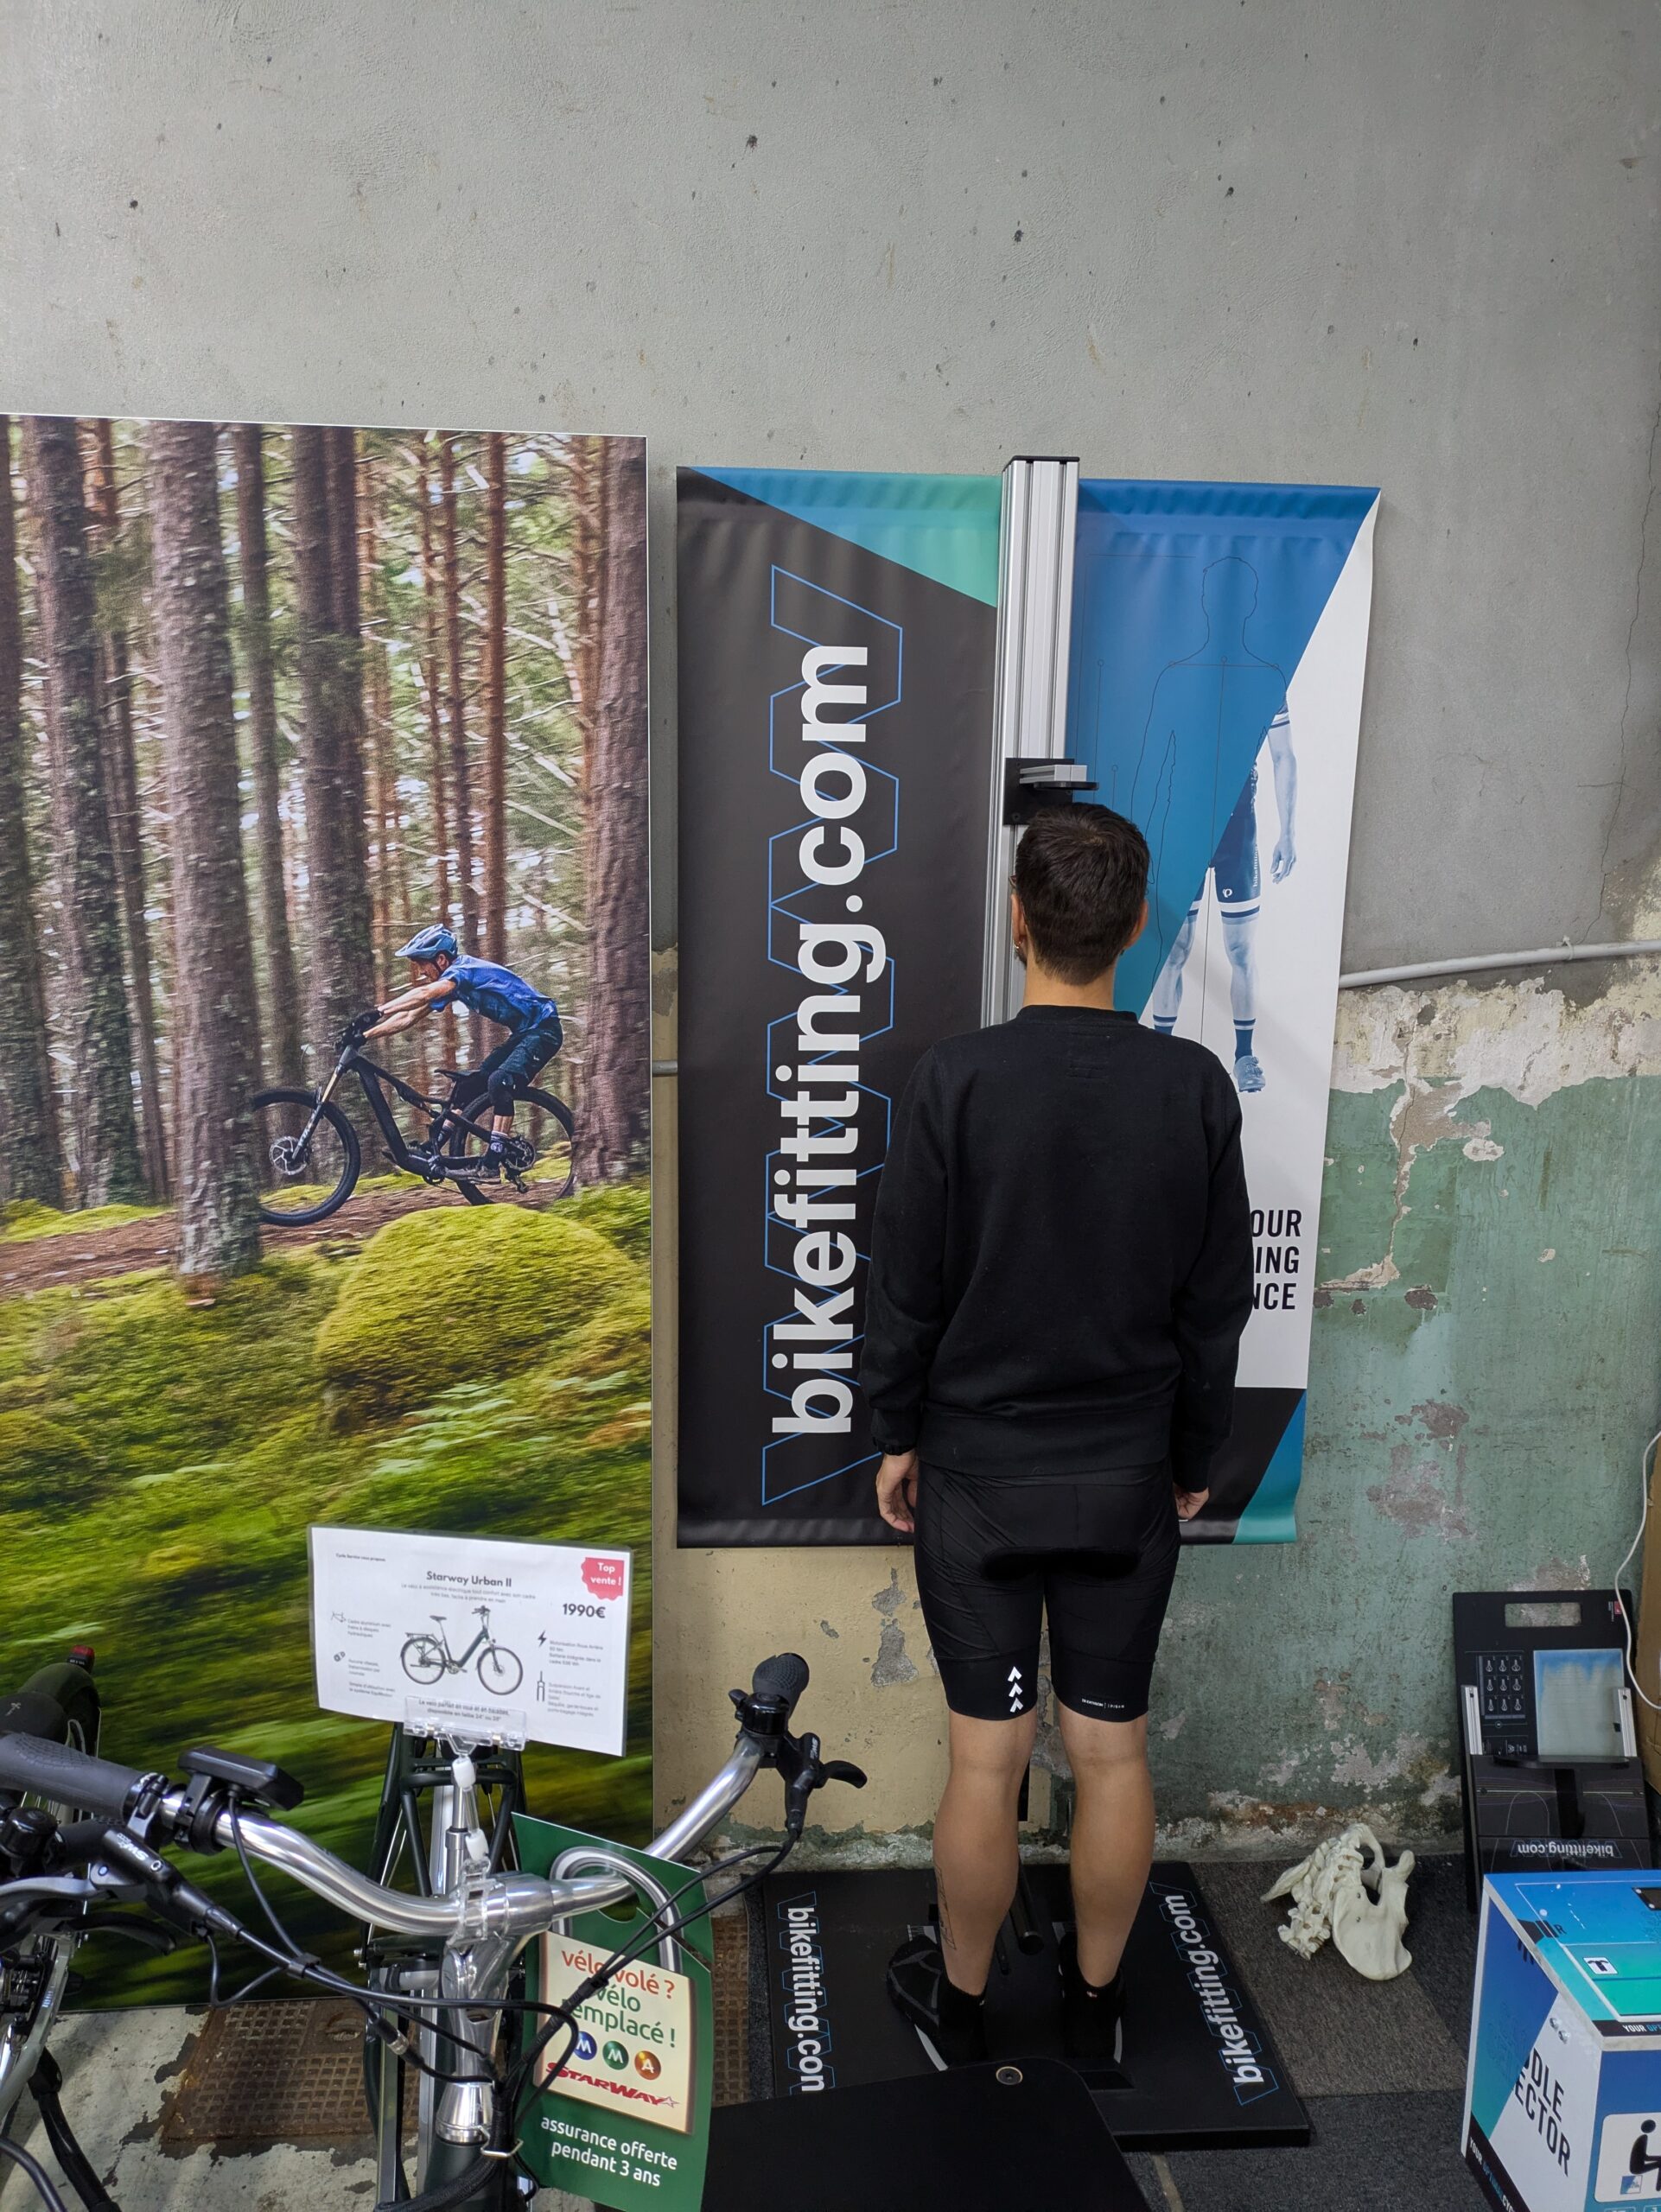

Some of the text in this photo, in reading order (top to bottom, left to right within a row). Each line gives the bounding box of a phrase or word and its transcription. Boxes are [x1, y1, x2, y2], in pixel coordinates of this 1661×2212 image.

[772, 645, 887, 1433] bikefitting.com
[1251, 1210, 1301, 1237] OUR
[1255, 1246, 1300, 1274] ING
[1252, 1282, 1296, 1310] NCE
[426, 1571, 468, 1586] Starway
[471, 1575, 503, 1586] Urban
[590, 1577, 616, 1586] vente
[597, 1562, 615, 1574] Top
[563, 1603, 606, 1618] 1990€
[1518, 1840, 1613, 1857] bikefitting.com
[597, 1984, 641, 2012] vélo
[614, 1970, 659, 1995] volé
[664, 1980, 675, 1999] ?
[1165, 1894, 1264, 2083] bikefitting.com
[563, 1999, 664, 2044] emplacé
[546, 2063, 665, 2106] STARWAY
[541, 2117, 678, 2171] assurance offerte
[551, 2142, 661, 2187] pendant 3 ans
